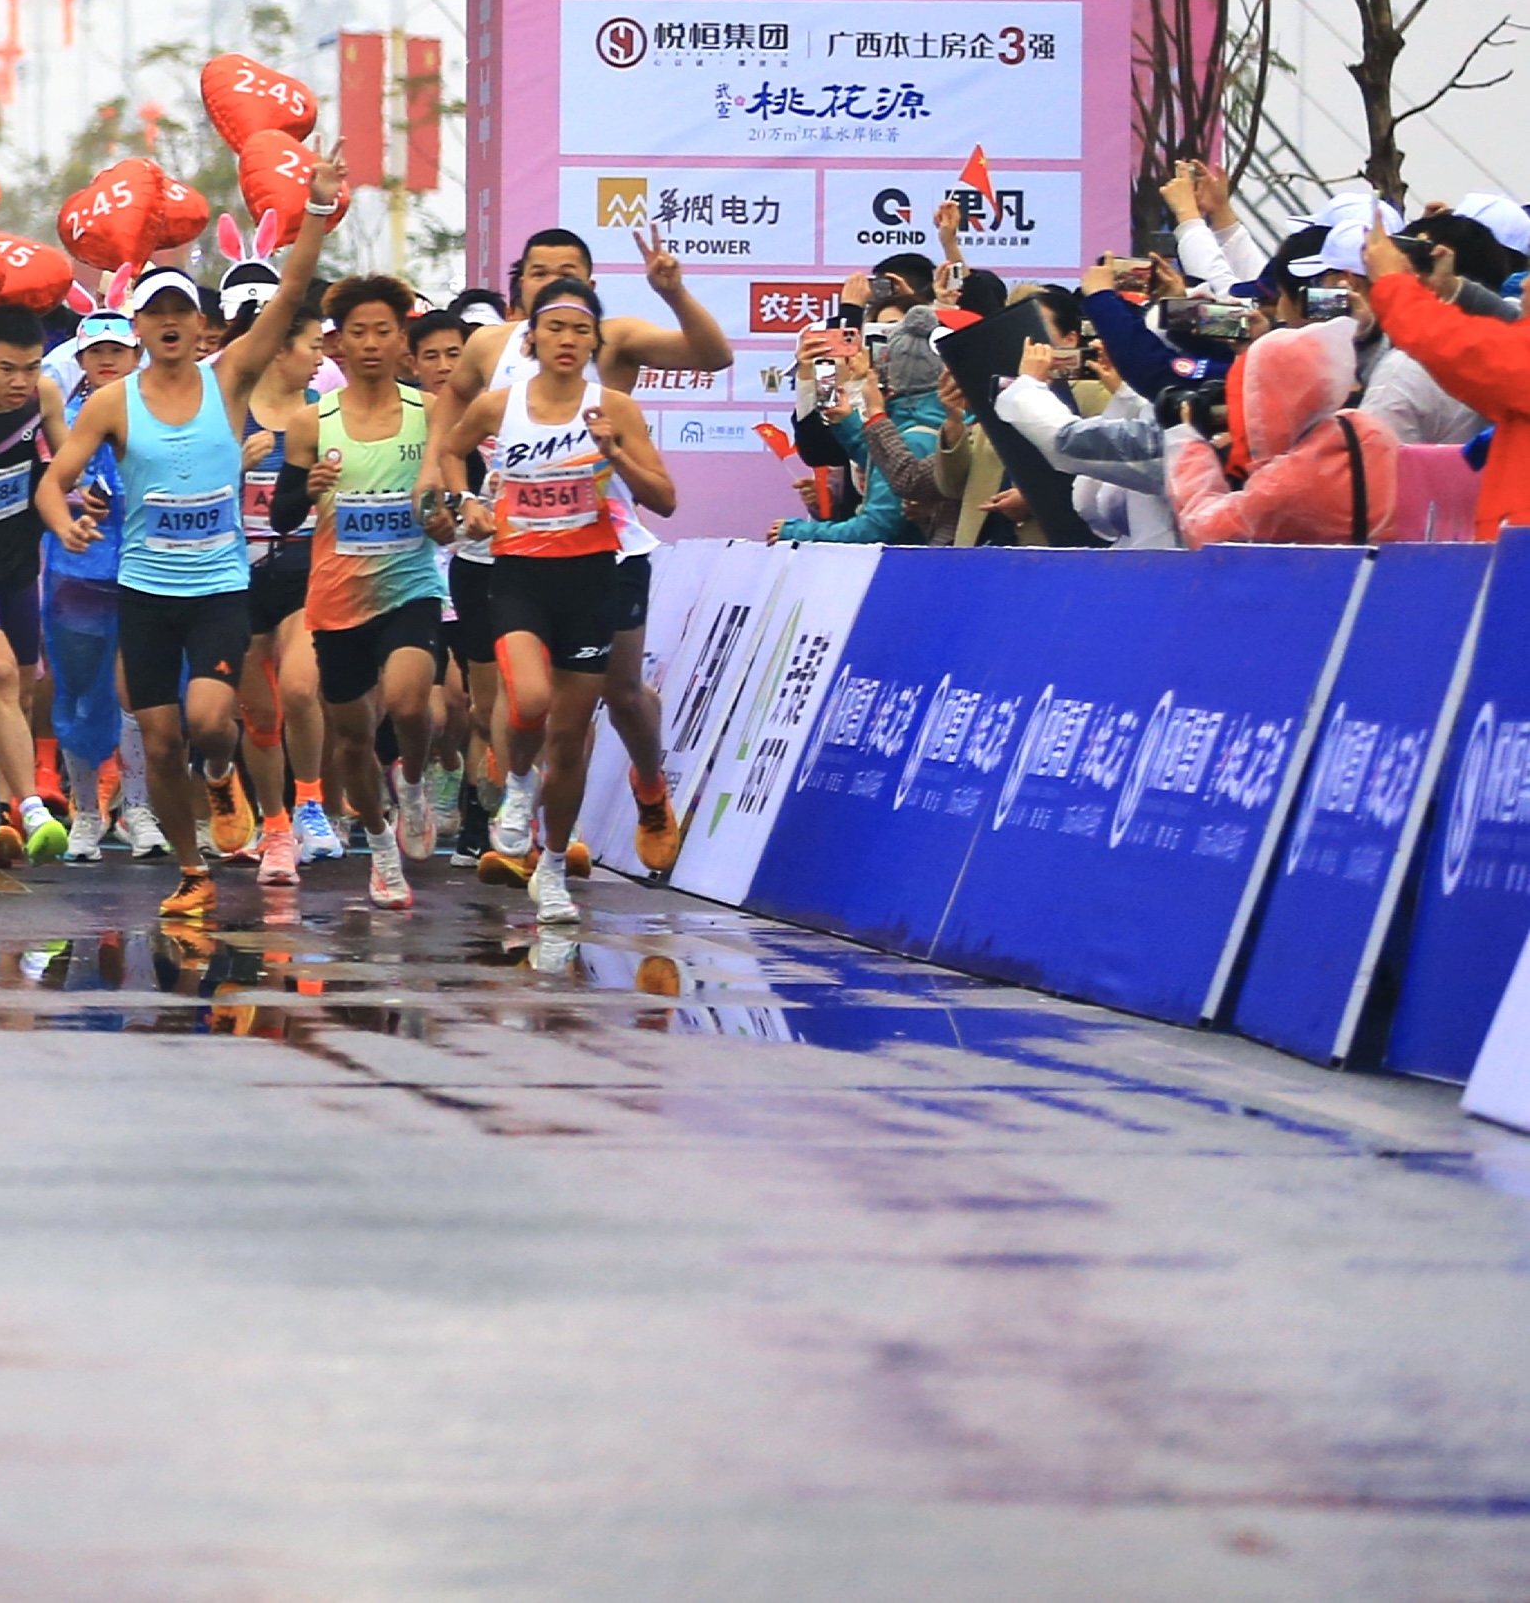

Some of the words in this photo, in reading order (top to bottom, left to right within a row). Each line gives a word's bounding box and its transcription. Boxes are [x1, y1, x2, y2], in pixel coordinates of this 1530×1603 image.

[653, 22, 790, 51] 悦恒集团
[827, 26, 1057, 66] 广西本土房企3强
[233, 67, 306, 118] 2:45
[745, 81, 932, 122] 桃花源
[64, 180, 134, 242] 2:45
[684, 239, 751, 255] POWER
[516, 485, 580, 509] A3561
[155, 508, 221, 531] A1909
[344, 509, 414, 532] A0958
